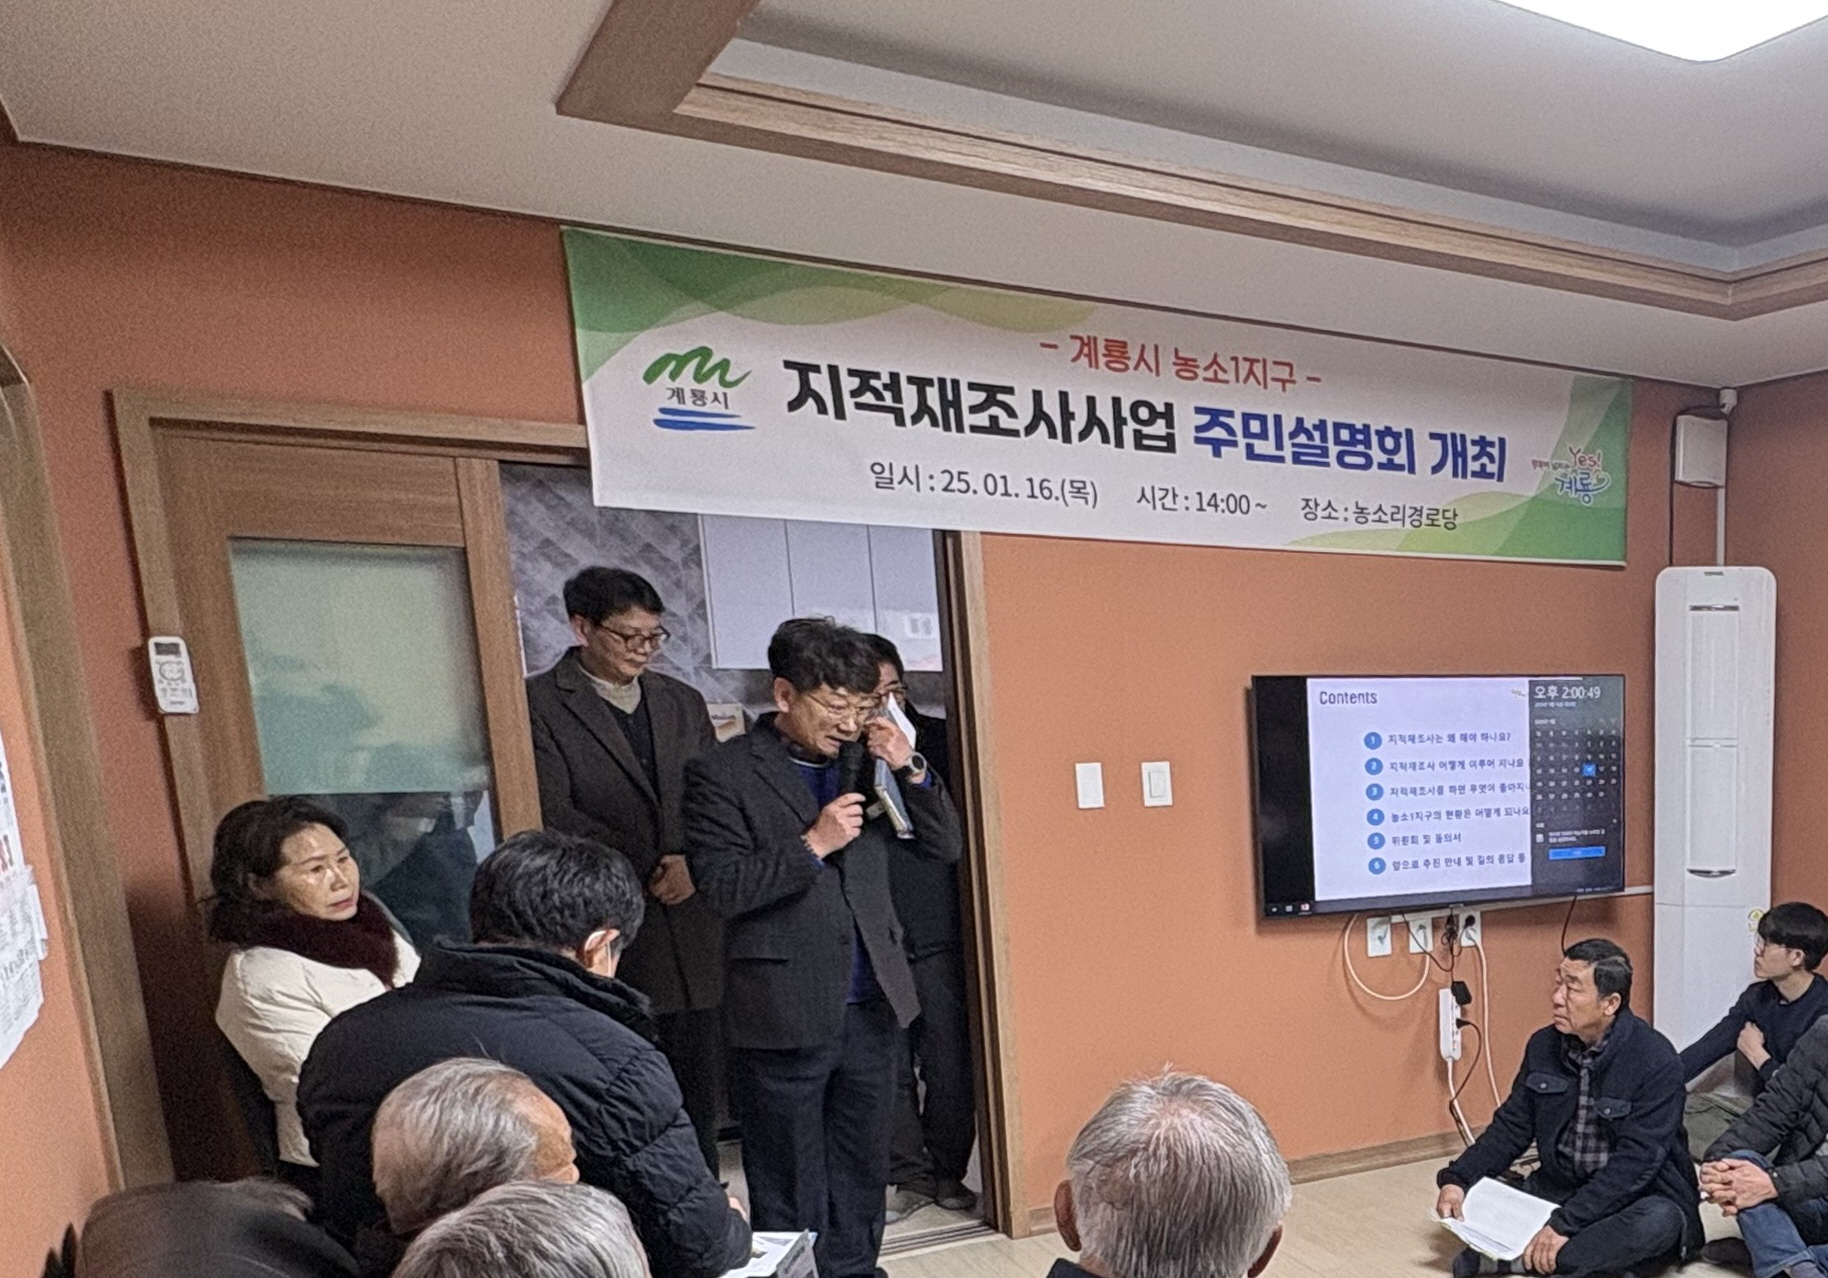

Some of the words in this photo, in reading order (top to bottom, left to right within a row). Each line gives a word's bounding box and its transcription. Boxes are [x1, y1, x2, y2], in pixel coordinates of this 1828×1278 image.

[1069, 334, 1161, 377] 계룡시
[1171, 347, 1297, 393] 농소1지구
[665, 386, 730, 410] 계룡시
[782, 358, 1177, 454] 지적재조사사업
[1193, 405, 1418, 476] 주민설명회
[1428, 430, 1508, 483] 개최
[1568, 446, 1601, 467] Yes!
[1554, 471, 1606, 504] 계룡
[1352, 500, 1459, 530] 농소리경로당
[1319, 690, 1378, 705] Contents
[1533, 684, 1559, 700] 오후
[1561, 685, 1602, 699] 2:00:49
[1388, 733, 1443, 745] 지적재조사는
[1390, 760, 1435, 772] 지적재조사
